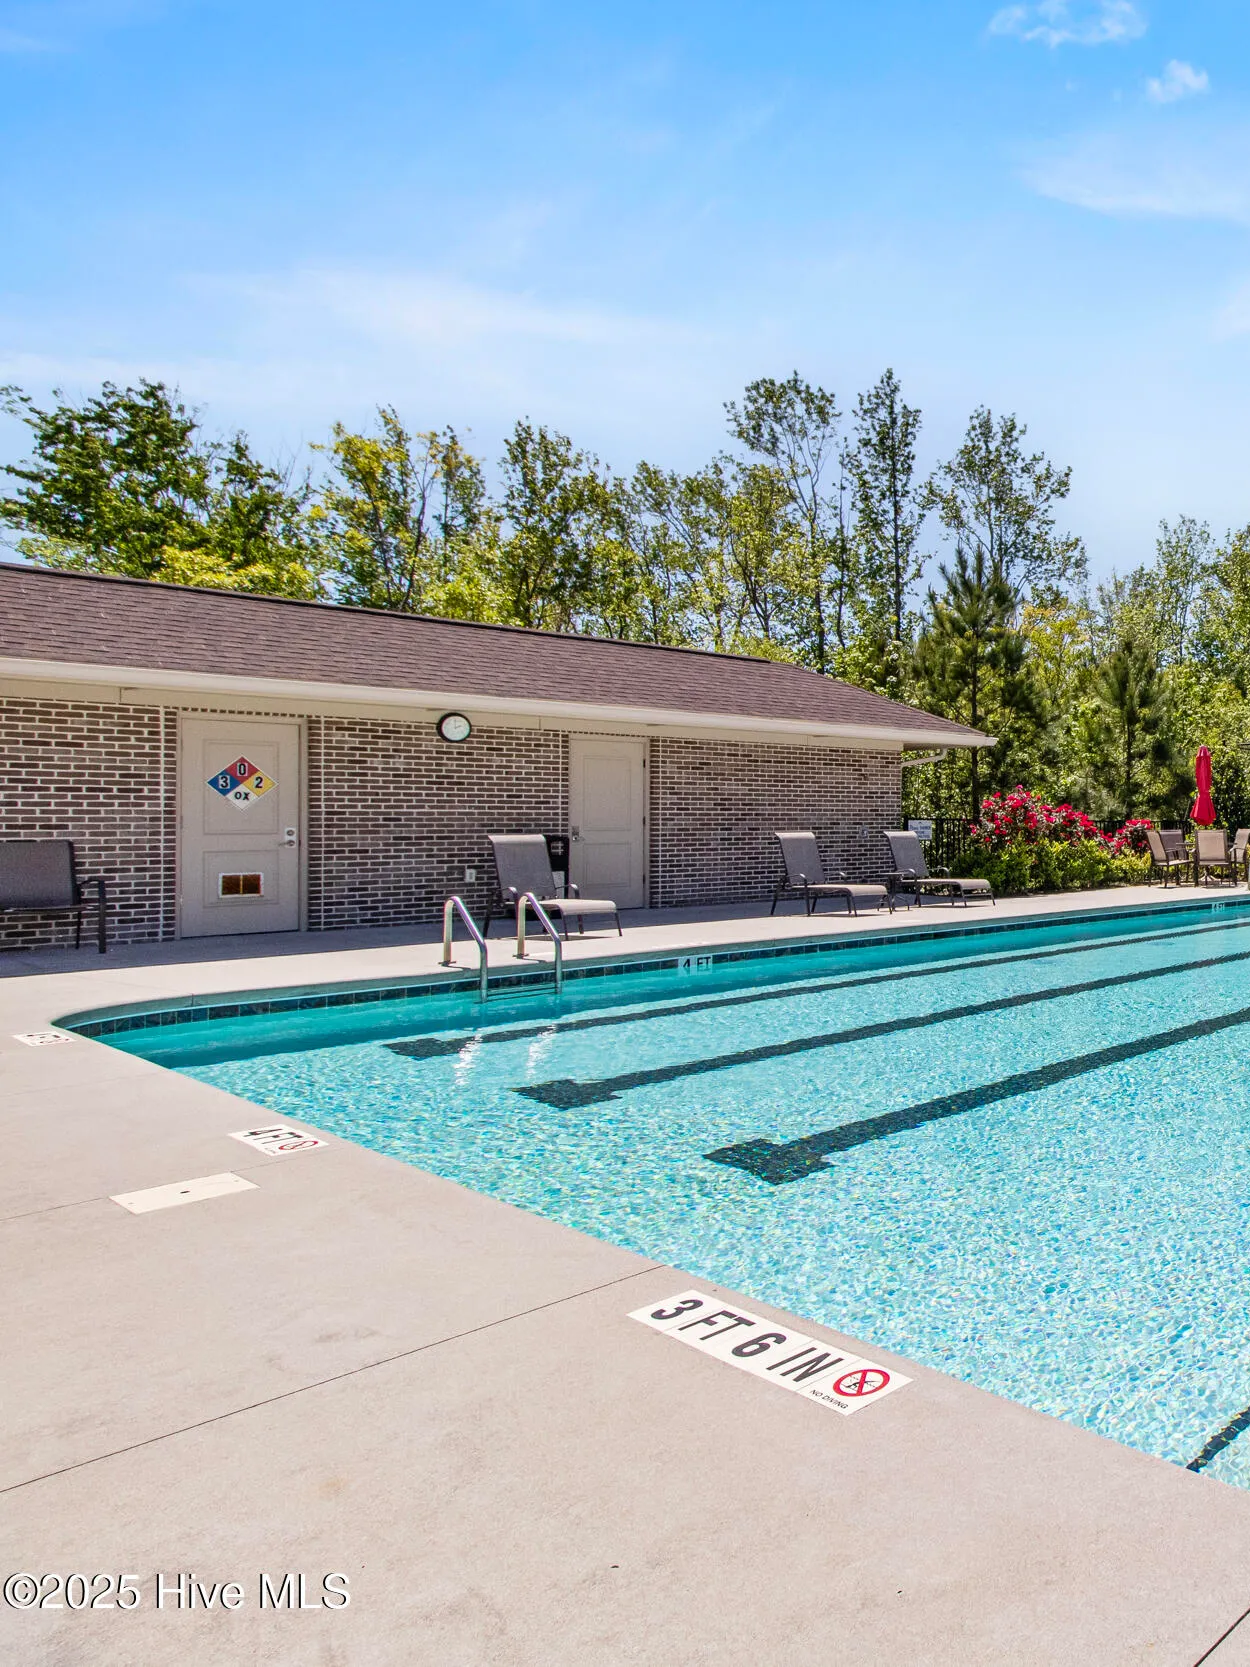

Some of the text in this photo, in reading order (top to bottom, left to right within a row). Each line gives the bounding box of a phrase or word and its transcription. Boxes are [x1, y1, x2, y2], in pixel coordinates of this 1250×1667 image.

[238, 763, 246, 776] 0
[220, 776, 263, 789] 3 2
[243, 1128, 304, 1145] 4 FT
[650, 1299, 844, 1383] 3 FT 6 IN
[810, 1389, 849, 1409] NO DIVING
